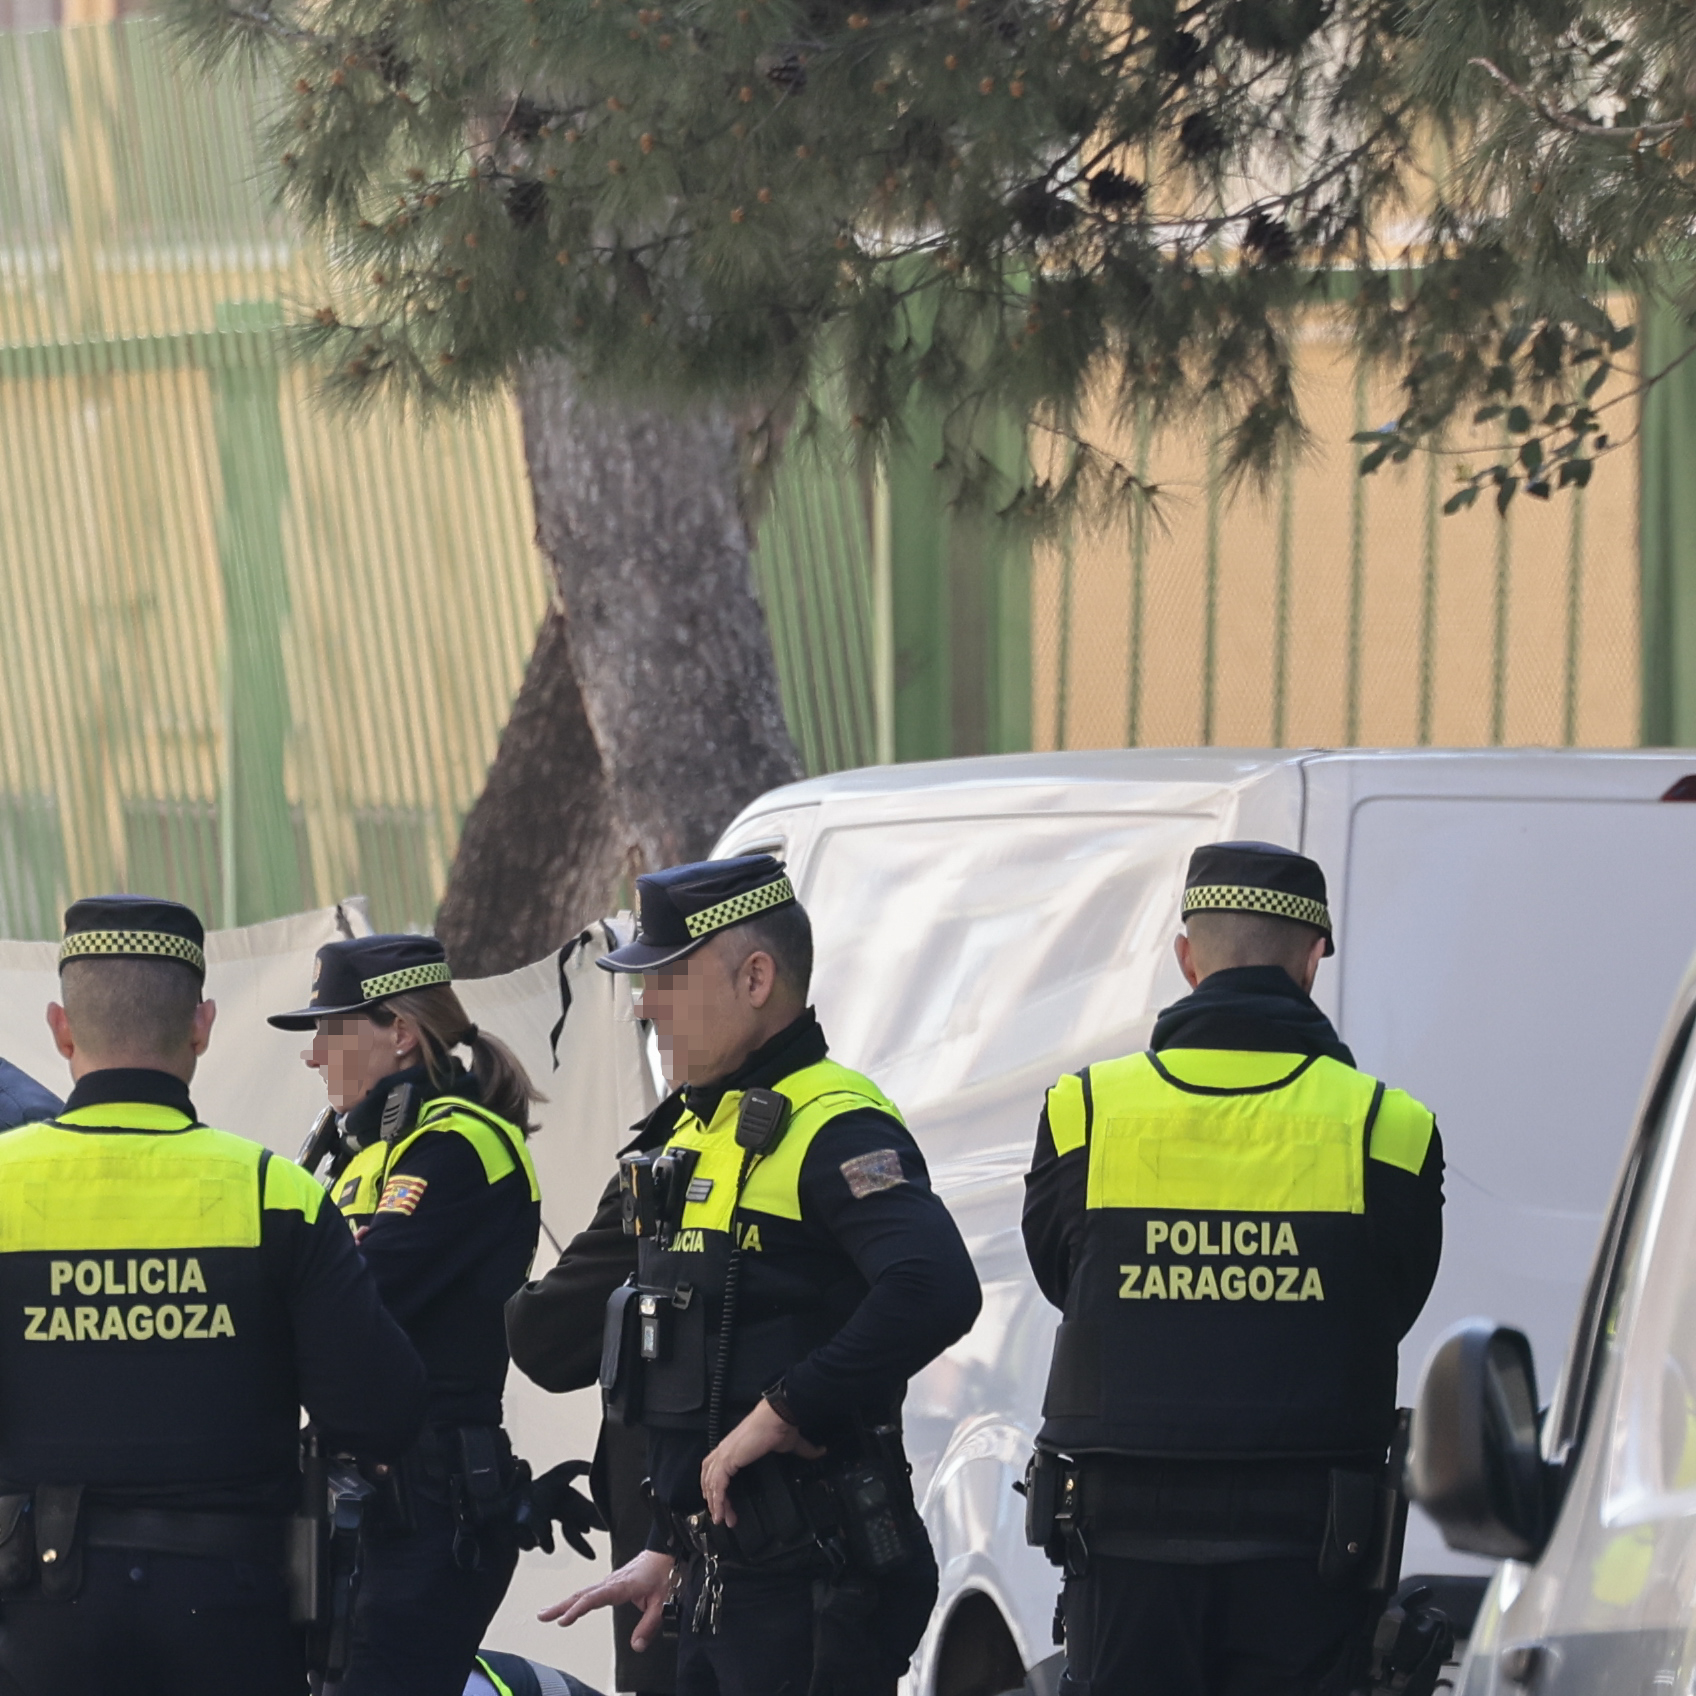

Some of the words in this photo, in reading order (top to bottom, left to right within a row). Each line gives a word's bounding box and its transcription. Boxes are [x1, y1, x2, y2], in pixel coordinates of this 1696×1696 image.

[1146, 1220, 1299, 1256] POLICIA
[50, 1258, 208, 1296] POLICIA
[1119, 1265, 1325, 1301] ZARAGOZA
[24, 1303, 236, 1341] ZARAGOZA
